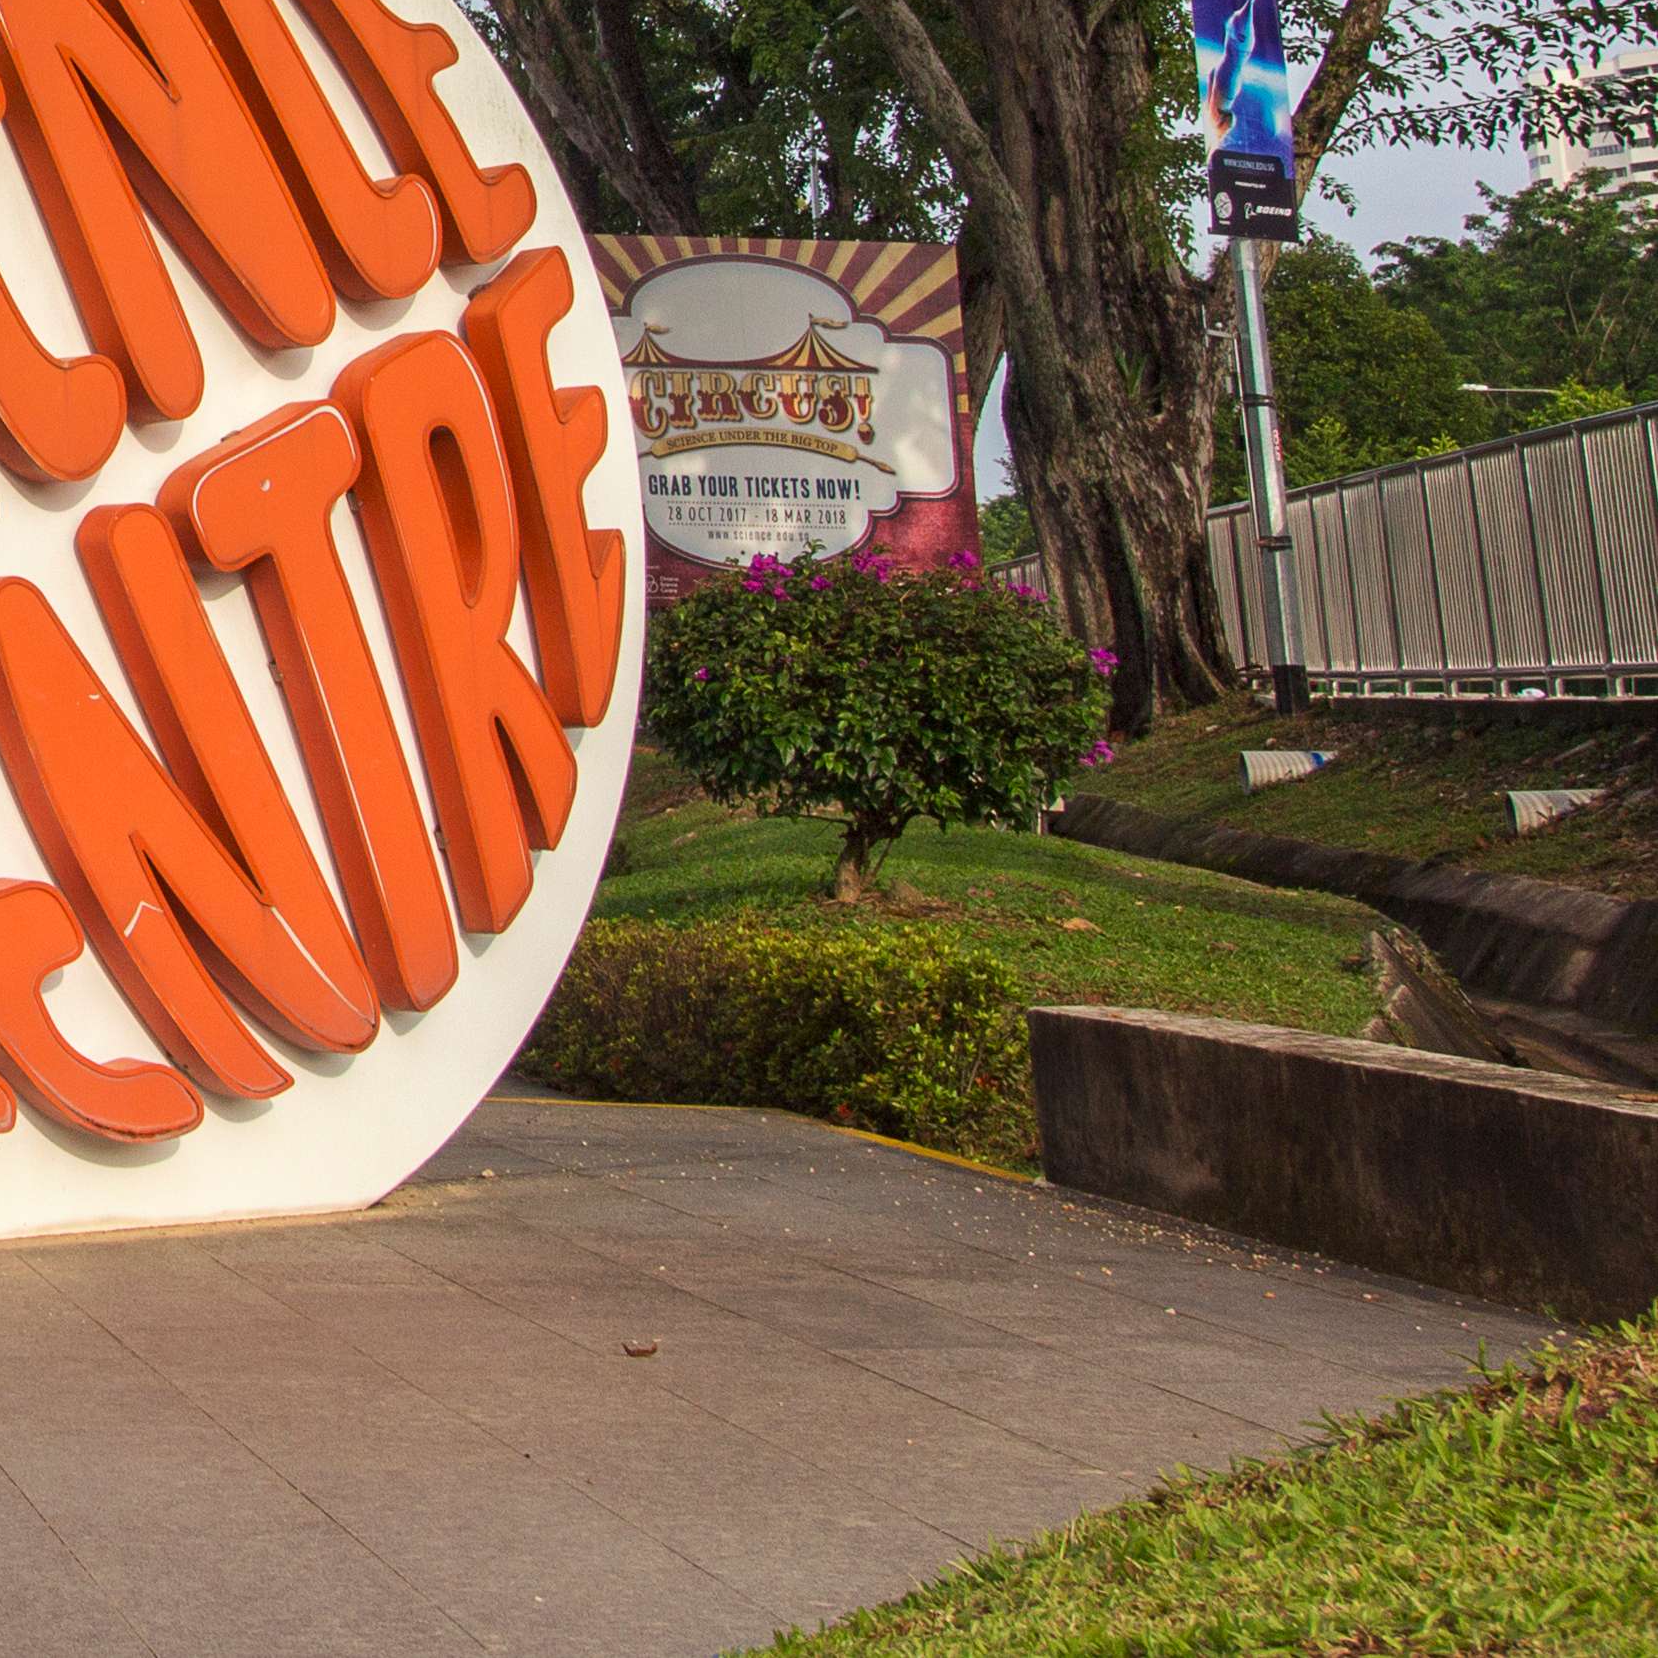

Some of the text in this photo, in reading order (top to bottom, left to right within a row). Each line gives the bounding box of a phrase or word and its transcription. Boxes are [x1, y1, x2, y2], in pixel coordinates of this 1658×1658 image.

[1256, 205, 1292, 217] BOEING
[629, 370, 874, 443] CIRCUS!
[667, 430, 838, 453] SCIENCE UNDER THE BIG TOP
[648, 474, 861, 500] GRAB YOUR TICKETS NOW!
[668, 506, 682, 521] 28
[689, 507, 712, 522] OCT
[720, 507, 746, 522] 2017
[765, 508, 778, 522] 18
[784, 509, 811, 524] MAR
[818, 510, 846, 524] 2018
